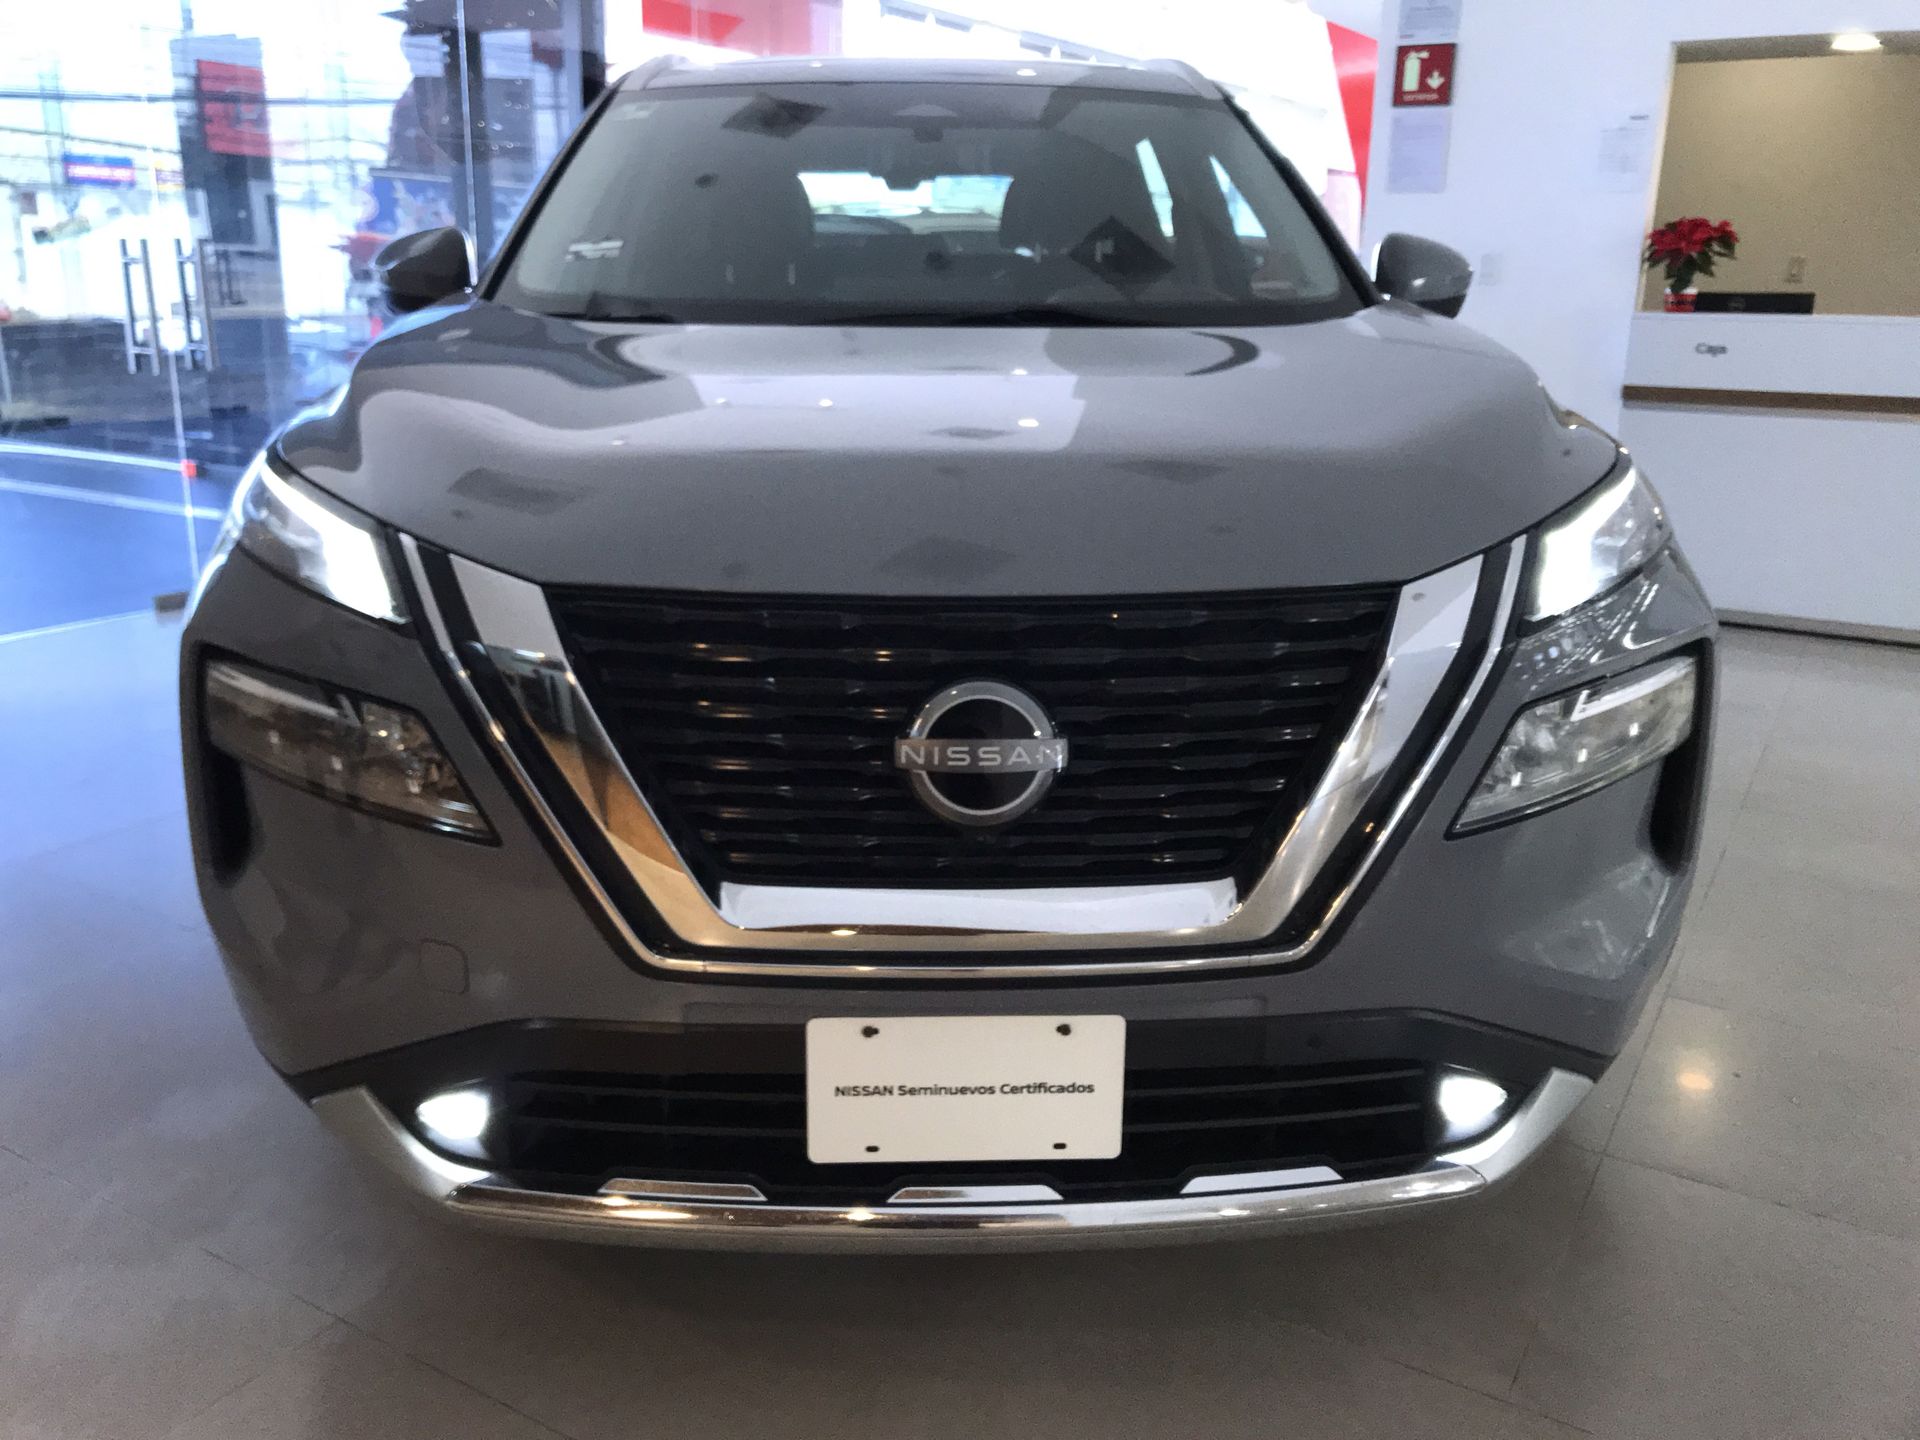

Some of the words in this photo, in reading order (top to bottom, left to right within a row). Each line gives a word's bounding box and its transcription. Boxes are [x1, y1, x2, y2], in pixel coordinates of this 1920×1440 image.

[901, 744, 1063, 768] NISSAN
[834, 1085, 894, 1097] NISSAN
[898, 1084, 996, 1096] Seminuevos
[1000, 1081, 1095, 1095] Certificados
